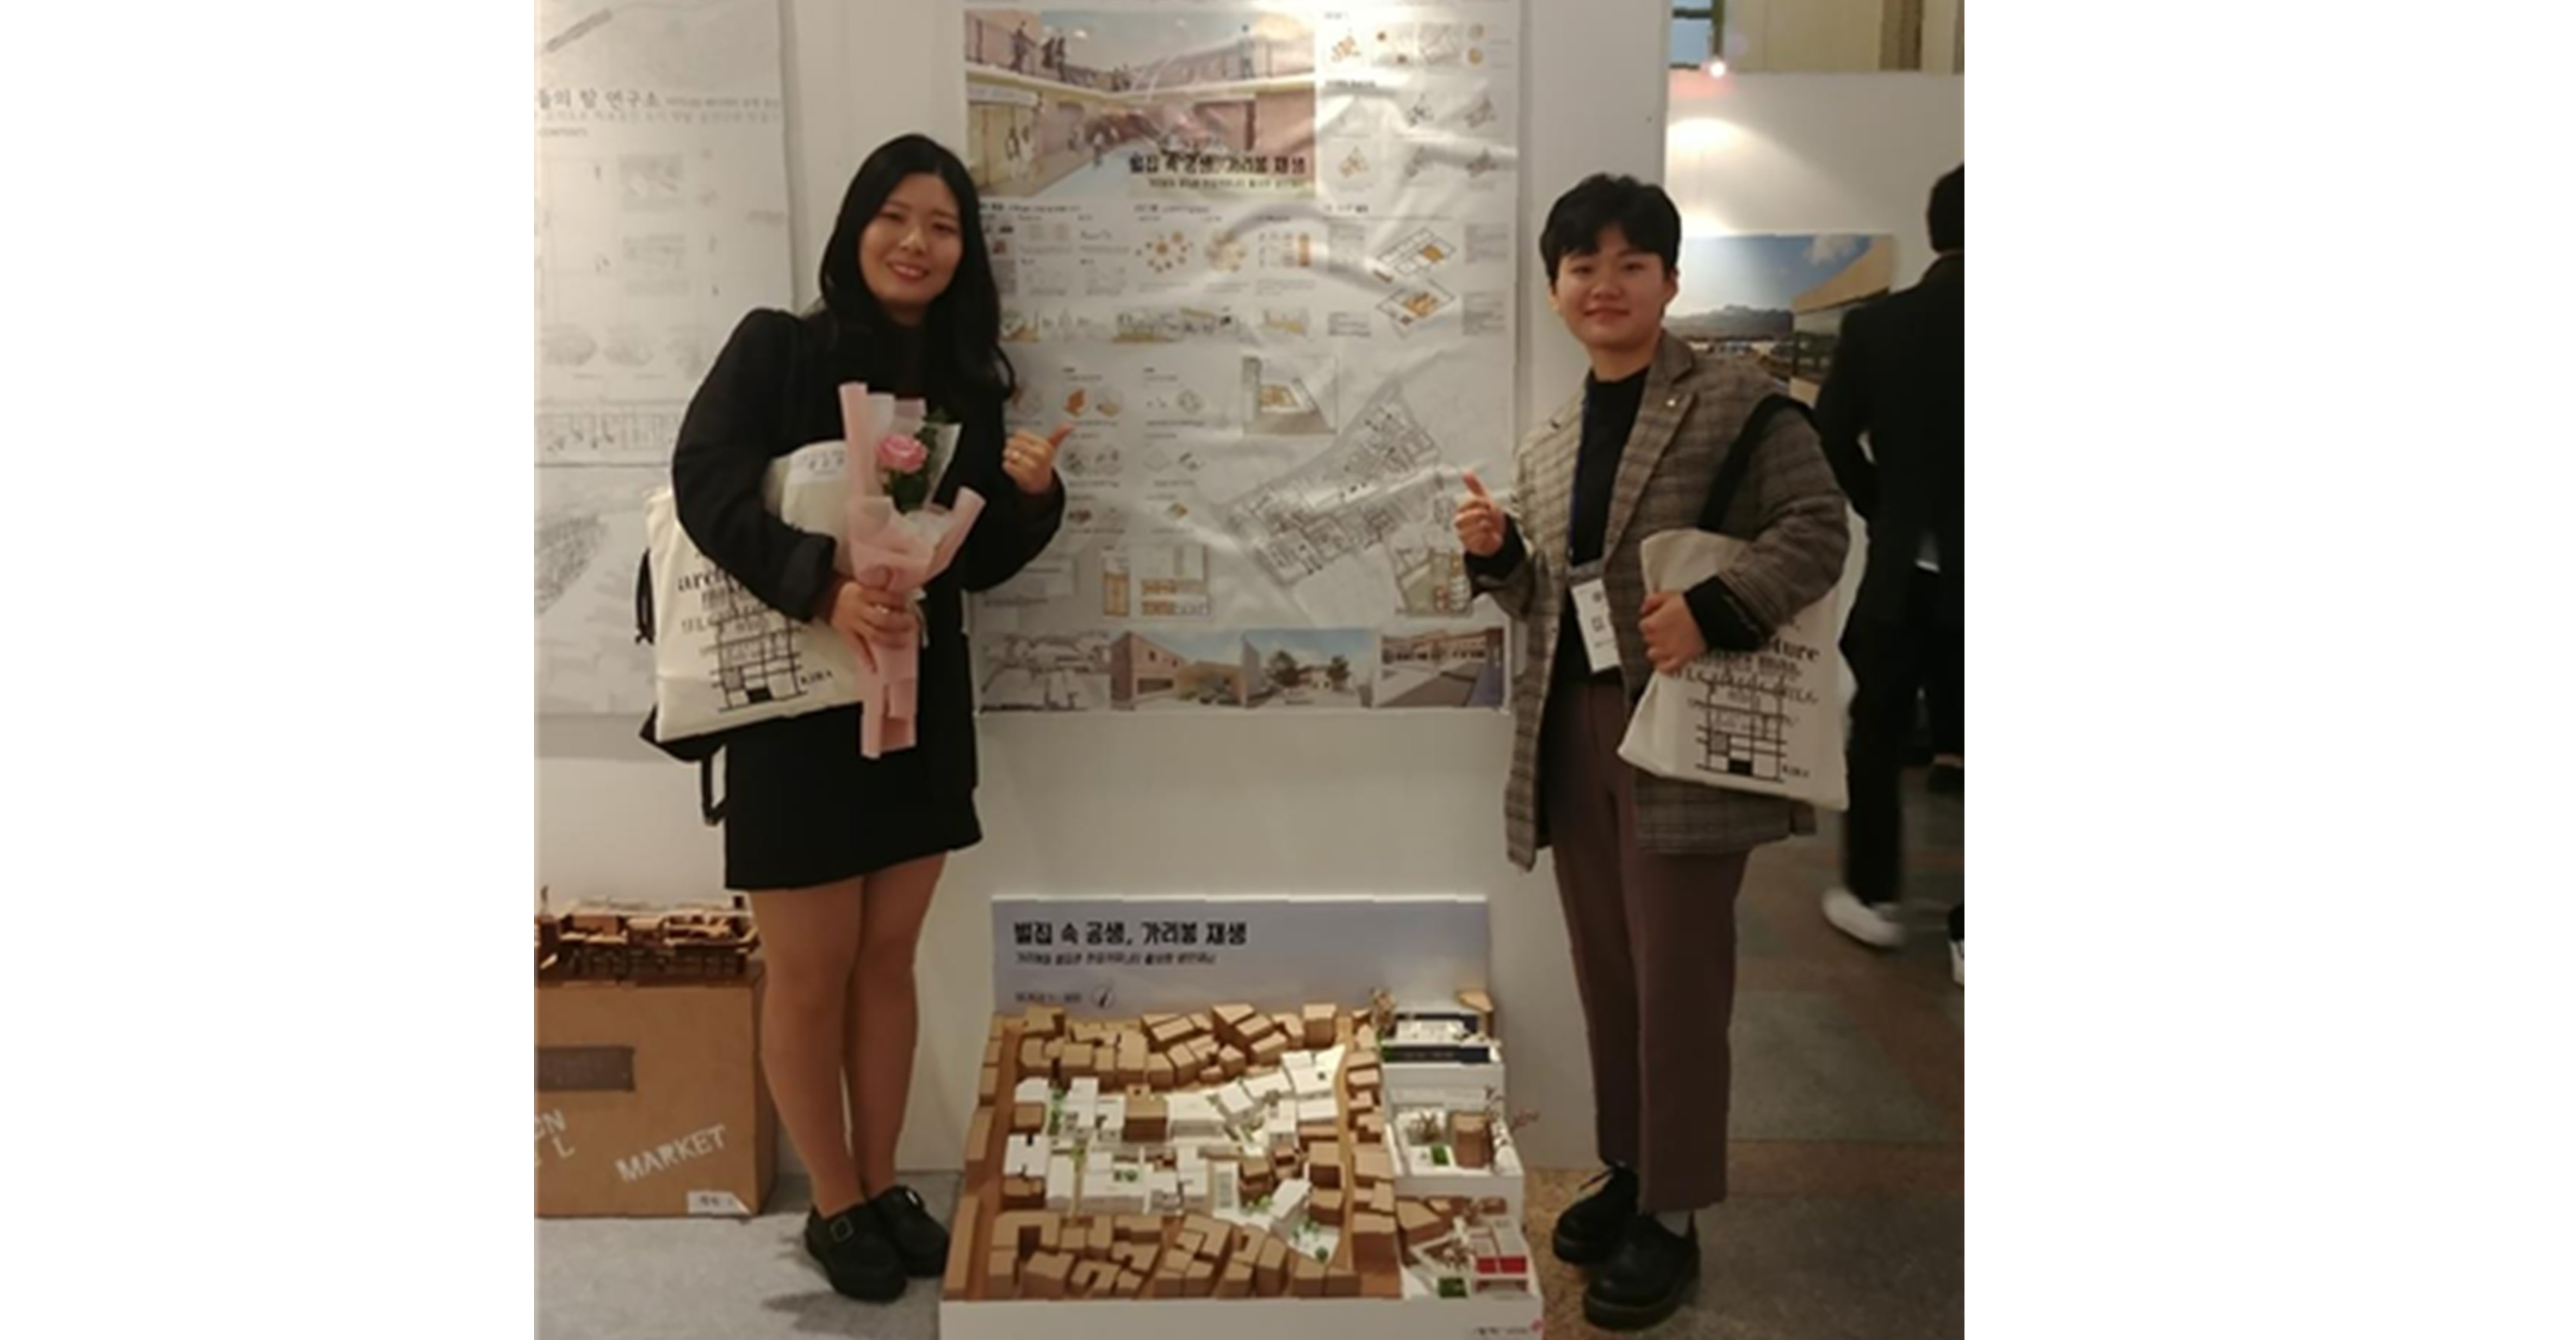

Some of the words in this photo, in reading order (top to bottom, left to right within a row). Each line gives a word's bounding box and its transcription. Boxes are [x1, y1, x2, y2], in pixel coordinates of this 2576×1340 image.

[1013, 921, 1053, 946] 벌집
[1060, 921, 1079, 946] 속
[1140, 920, 1198, 946] 가리봉
[1205, 921, 1247, 946] 재생
[614, 1124, 725, 1183] MARKET
